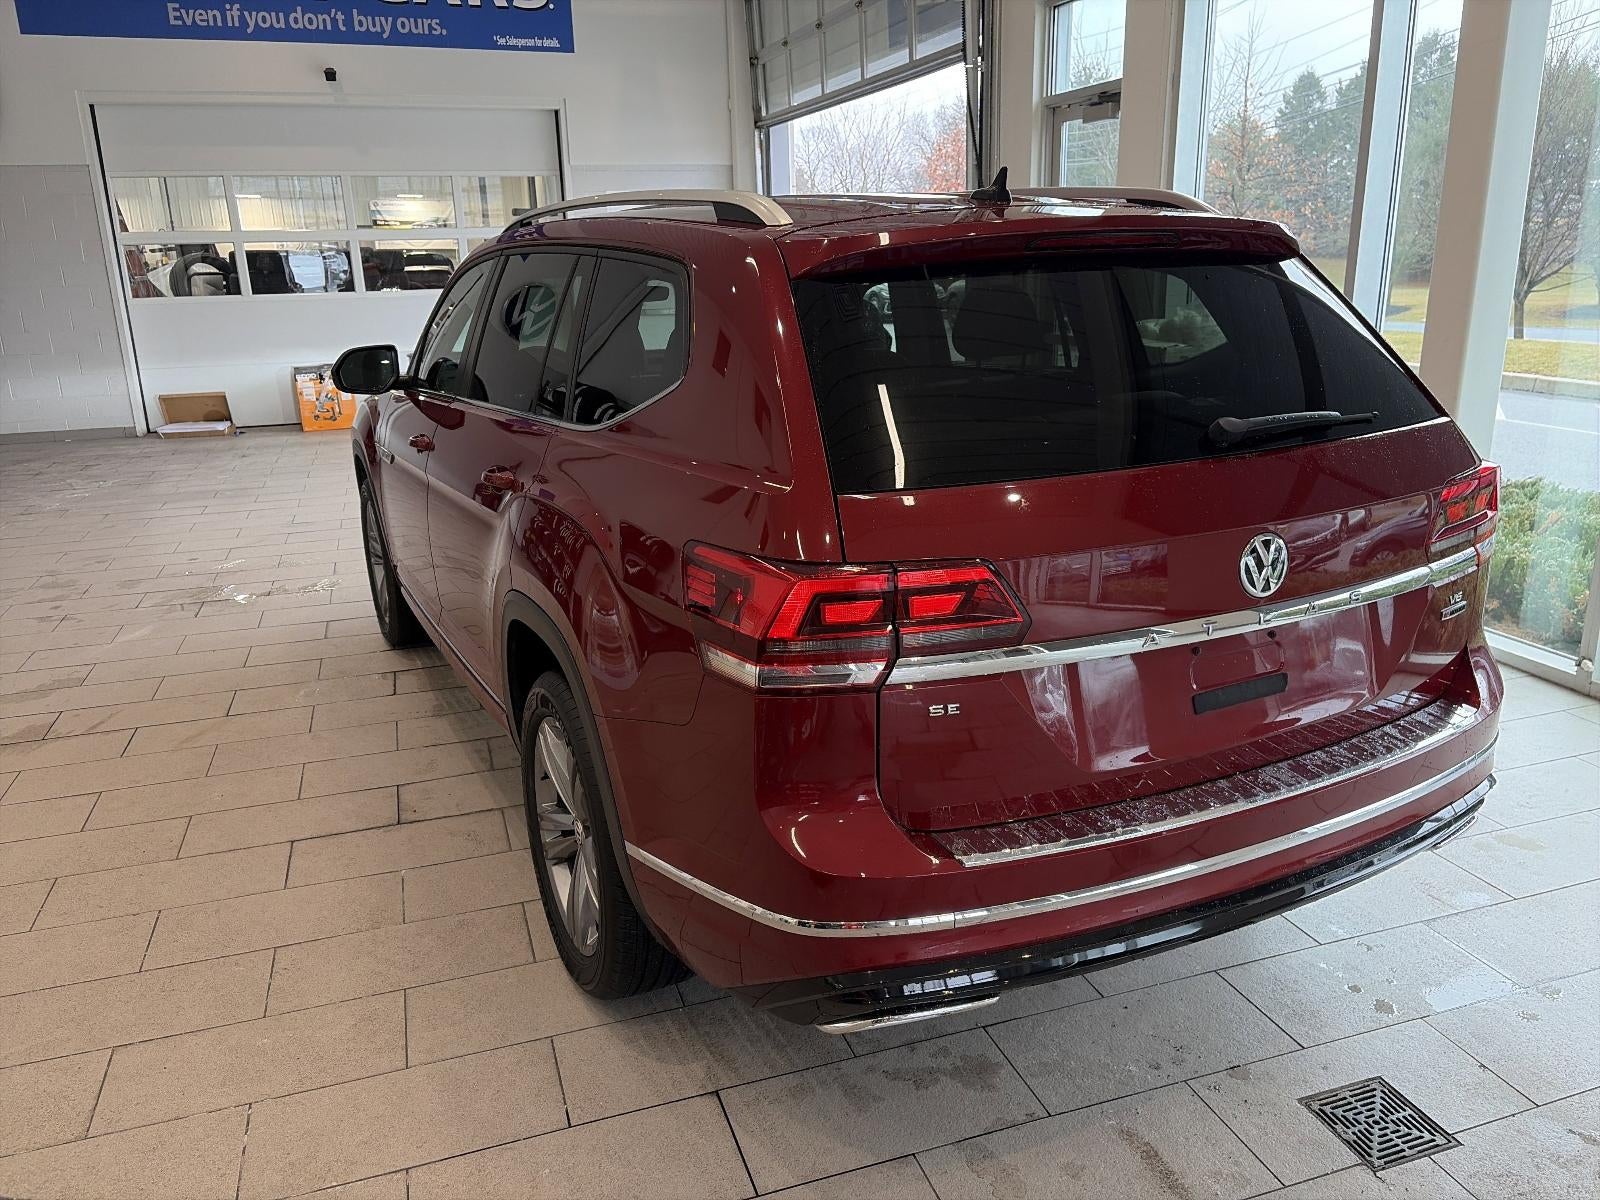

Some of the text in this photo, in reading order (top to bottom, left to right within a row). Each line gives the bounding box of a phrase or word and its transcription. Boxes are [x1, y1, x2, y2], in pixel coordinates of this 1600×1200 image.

[166, 3, 447, 39] Even if you don't buy ours.
[506, 35, 535, 48] Salesperson
[535, 36, 543, 47] for
[543, 37, 560, 48] details.
[1240, 533, 1288, 598] VW
[1449, 590, 1463, 605] V6
[1142, 591, 1362, 649] ATLAS
[929, 703, 960, 717] SE
